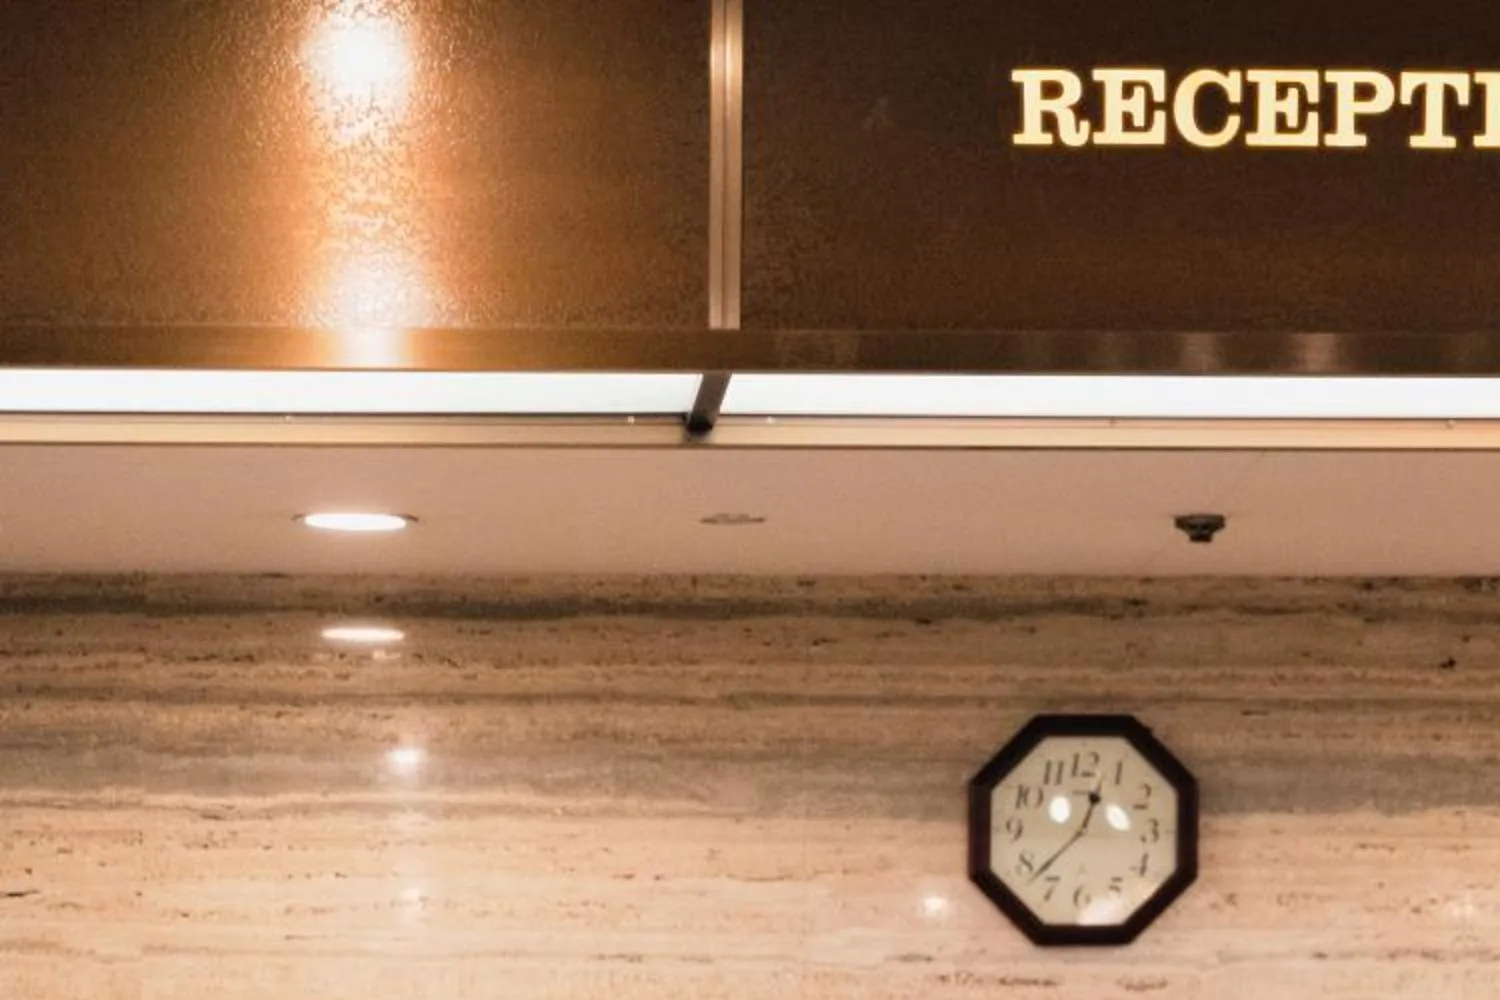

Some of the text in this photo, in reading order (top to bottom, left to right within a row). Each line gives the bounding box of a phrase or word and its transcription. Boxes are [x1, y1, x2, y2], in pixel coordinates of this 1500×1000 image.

[1043, 759, 1065, 786] 11
[1071, 751, 1100, 778] 12
[1114, 759, 1124, 786] 1
[1014, 783, 1044, 810] 10
[1132, 782, 1152, 811] 2
[1005, 817, 1025, 844] 9
[1139, 818, 1160, 844] 3
[1015, 849, 1036, 876] 8
[1129, 852, 1150, 878] 4
[1043, 874, 1061, 901] 7
[1072, 883, 1093, 909] 6
